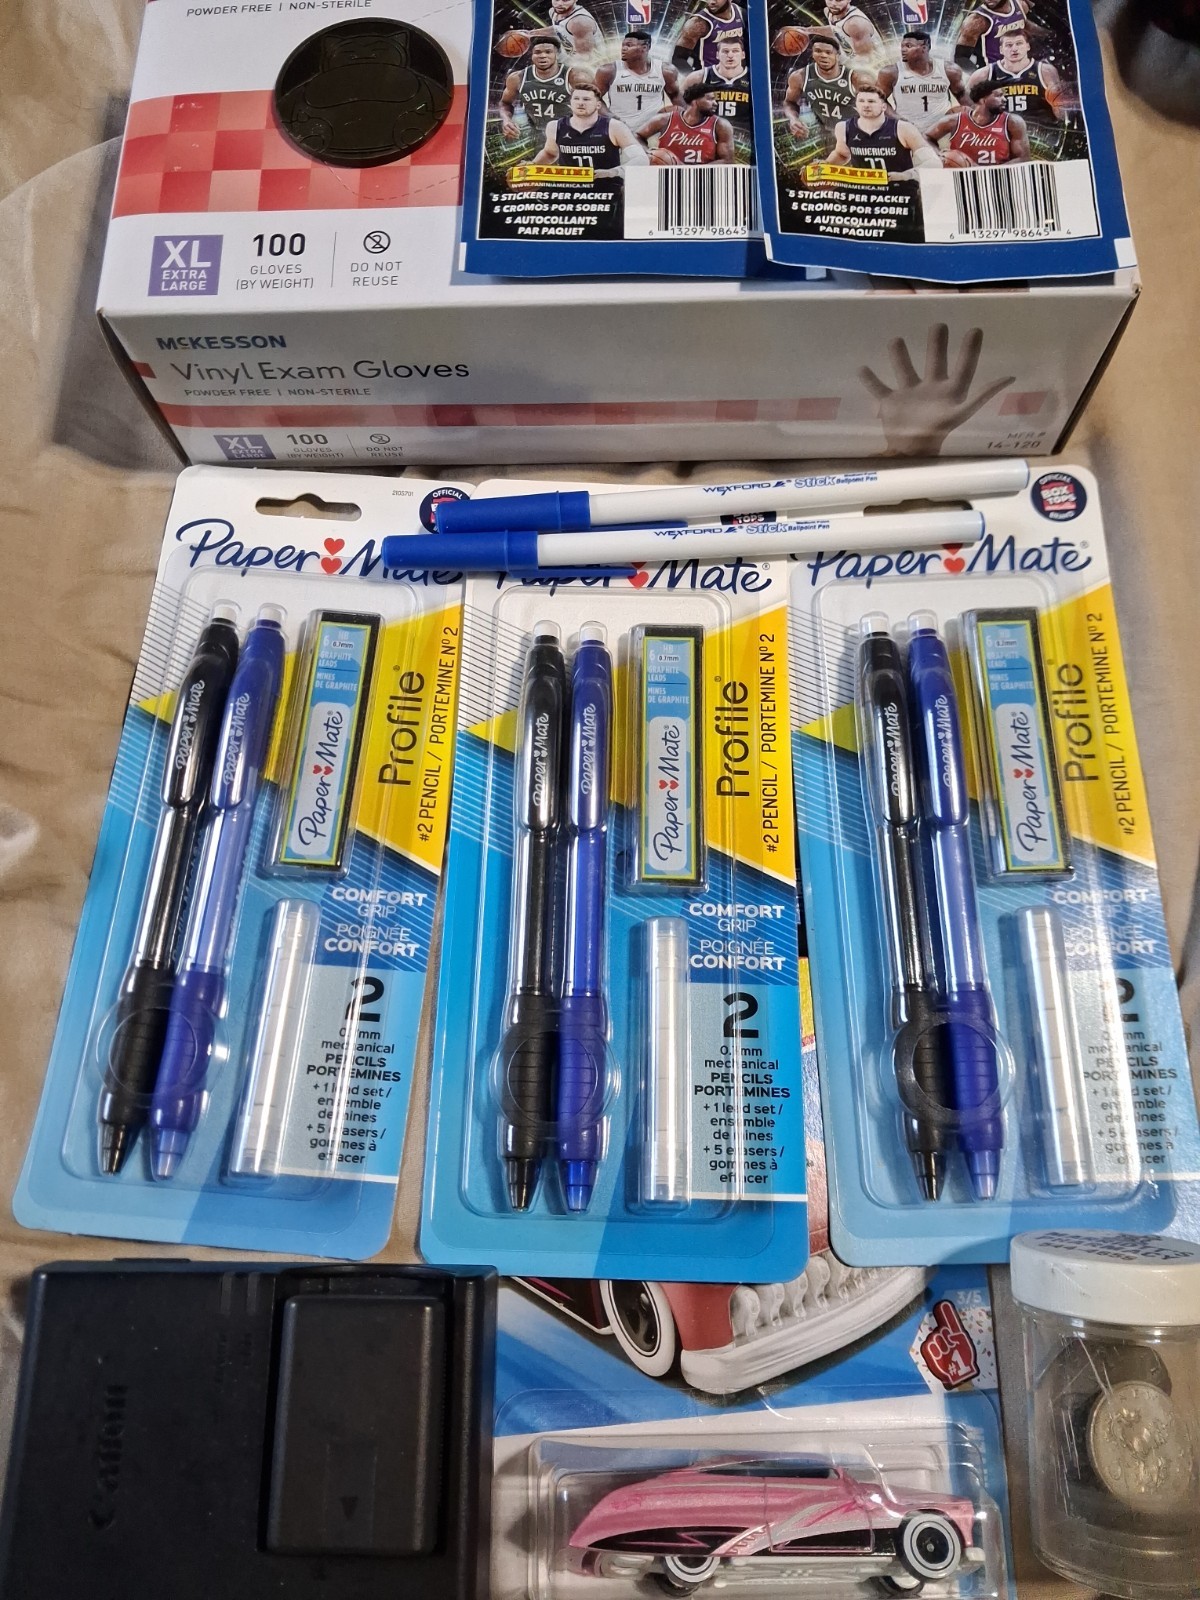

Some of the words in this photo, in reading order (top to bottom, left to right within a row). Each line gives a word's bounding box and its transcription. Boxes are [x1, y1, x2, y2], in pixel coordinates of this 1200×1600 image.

[187, 5, 237, 17] POWDER
[241, 3, 272, 14] FREE
[289, 0, 372, 11] NON-STERILE
[521, 88, 565, 104] BUCKS
[616, 84, 633, 93] NEW
[900, 85, 917, 94] NEW
[918, 84, 948, 94] ORLEANS
[1003, 85, 1039, 96] ENVER
[635, 95, 642, 111] 1
[714, 91, 749, 103] ENVER
[808, 88, 850, 106] BUCKS
[921, 95, 929, 112] 1
[1006, 95, 1028, 112] 15
[531, 103, 556, 119] 34
[717, 101, 737, 117] 15
[821, 104, 842, 120] 34
[668, 132, 704, 147] Phila
[959, 132, 997, 148] Phila
[684, 149, 702, 163] 21
[977, 150, 997, 164] 21
[535, 167, 591, 177] PANINI
[829, 166, 885, 179] PANINI
[491, 194, 500, 202] 5
[501, 192, 550, 201] STICKERS
[551, 192, 571, 200] PER
[573, 192, 614, 201] PACKET
[788, 190, 797, 198] 5
[798, 190, 846, 201] STICKERS
[848, 194, 868, 202] PER
[870, 195, 911, 204] PACKET
[493, 205, 501, 213] 5
[502, 204, 549, 213] CROMOS
[551, 204, 574, 212] POR
[575, 204, 611, 212] SOBRE
[791, 202, 799, 211] 5
[800, 202, 848, 213] CROMOS
[849, 205, 872, 215] POR
[874, 206, 909, 216] SOBRE
[505, 216, 512, 224] 5
[513, 215, 598, 225] AUTOCOLLANTS
[804, 215, 812, 223] 5
[813, 215, 897, 228] AUTOCOLLANTS
[517, 227, 539, 236] PAR
[541, 227, 585, 236] PAQUET
[670, 227, 705, 236] 13297
[711, 227, 747, 236] 98645
[819, 225, 841, 235] PAR
[842, 227, 885, 238] PAQUET
[971, 229, 1006, 239] 13297
[1012, 228, 1050, 238] 98645
[252, 233, 306, 257] 100
[160, 239, 212, 269] XL
[250, 264, 302, 276] GLOVES
[350, 262, 372, 272] DO
[376, 260, 402, 272] NOT
[162, 269, 207, 281] EXTRA
[352, 274, 399, 287] REUSE
[161, 280, 207, 292] LARGE
[236, 278, 260, 291] (BY
[262, 277, 314, 290] WEIGHT)
[170, 361, 253, 385] Vinyl
[257, 361, 345, 381] Exam
[353, 359, 470, 380] Gloves
[184, 388, 237, 398] POWDER
[239, 388, 272, 397] FREE
[288, 387, 371, 397] NON-STERILE
[222, 436, 264, 450] XL
[286, 433, 328, 445] 100
[987, 440, 1041, 450] 14-120
[703, 482, 771, 496] WEXFORD
[794, 475, 836, 489] Stick
[865, 475, 878, 483] Pen
[1041, 485, 1069, 499] BOX
[432, 488, 464, 500] OFFICIAL
[1046, 493, 1077, 506] TOPS
[736, 513, 764, 524] TOPS
[654, 526, 722, 540] WEXFORD
[746, 522, 788, 535] Stick
[788, 524, 816, 532] Ballpoint
[176, 518, 321, 577] Paper
[966, 534, 1093, 573] Mate
[647, 556, 773, 596] Mate
[763, 633, 775, 643] 2
[318, 659, 338, 668] LEADS
[316, 672, 336, 681] MINES
[647, 673, 667, 682] LEADS
[315, 680, 324, 689] DE
[325, 681, 358, 692] GRAPHITE
[647, 687, 667, 695] MINES
[1091, 648, 1118, 735] PORTEMINE
[183, 680, 205, 722] Mate
[429, 658, 455, 745] PORTEMINE
[647, 695, 656, 704] DE
[657, 695, 690, 704] GRAPHITE
[760, 666, 777, 754] PORTEMINE
[933, 694, 947, 735] Mate
[377, 669, 425, 787] Profile
[583, 703, 596, 744] Mate
[883, 702, 898, 743] Mate
[1052, 663, 1099, 783] Profile
[223, 734, 243, 786] Paper
[233, 692, 250, 731] Mate
[315, 711, 344, 767] Mate
[535, 712, 549, 754] Mate
[715, 679, 750, 797] Profile
[1011, 711, 1034, 769] Mate
[175, 719, 196, 770] Paper
[658, 724, 680, 782] Mate
[581, 748, 597, 796] Paper
[887, 746, 901, 797] Paper
[937, 740, 952, 788] Paper
[533, 757, 549, 807] Paper
[1111, 755, 1134, 811] PENCIL
[419, 769, 441, 820] PENCIL
[762, 773, 779, 830] PENCIL
[299, 775, 333, 846] Paper
[1016, 779, 1047, 853] Paper
[417, 822, 433, 842] #2
[653, 789, 684, 862] Paper
[1118, 815, 1135, 835] #2
[766, 833, 780, 853] #2
[332, 886, 427, 907] COMFORT
[357, 904, 397, 918] GRIP
[689, 902, 785, 919] COMFORT
[717, 918, 756, 933] GRIP
[324, 937, 420, 958] CONFORT
[700, 936, 775, 956] POIGNÉE
[690, 955, 786, 971] CONFORT
[344, 975, 385, 1023] 2
[723, 991, 759, 1039] 2
[321, 1039, 395, 1054] mecanical
[325, 1053, 387, 1068] PECILS
[363, 1086, 384, 1098] set
[694, 1084, 791, 1099] PORTMINES
[1143, 1086, 1165, 1096] set
[754, 1105, 776, 1115] set
[710, 1116, 775, 1128] ensmble
[713, 1129, 729, 1140] de
[957, 1289, 982, 1305] 3/5
[948, 1349, 972, 1377] #1
